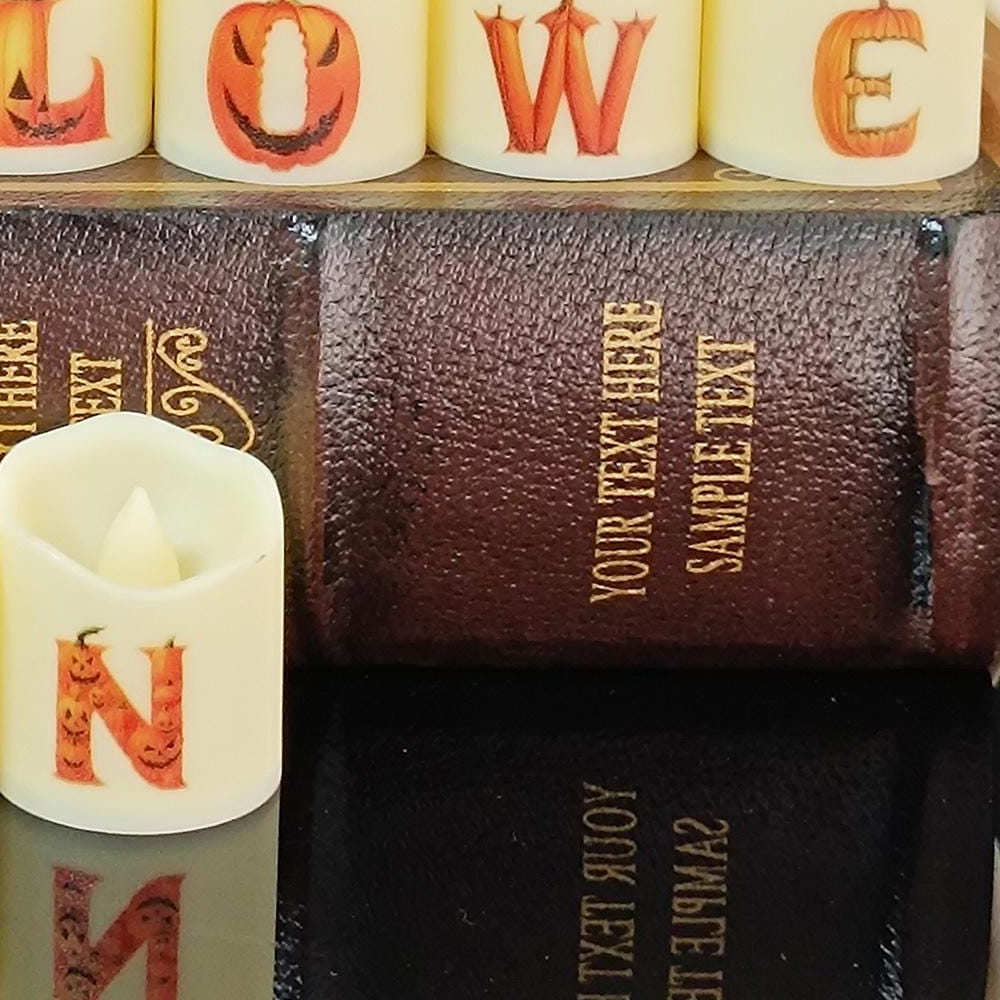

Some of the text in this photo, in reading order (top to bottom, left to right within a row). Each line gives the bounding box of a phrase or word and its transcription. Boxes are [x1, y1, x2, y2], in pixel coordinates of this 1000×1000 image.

[69, 351, 122, 425] EXT
[590, 300, 663, 603] YOUR TEXT HERE
[686, 335, 756, 575] SAMPLE TEXT
